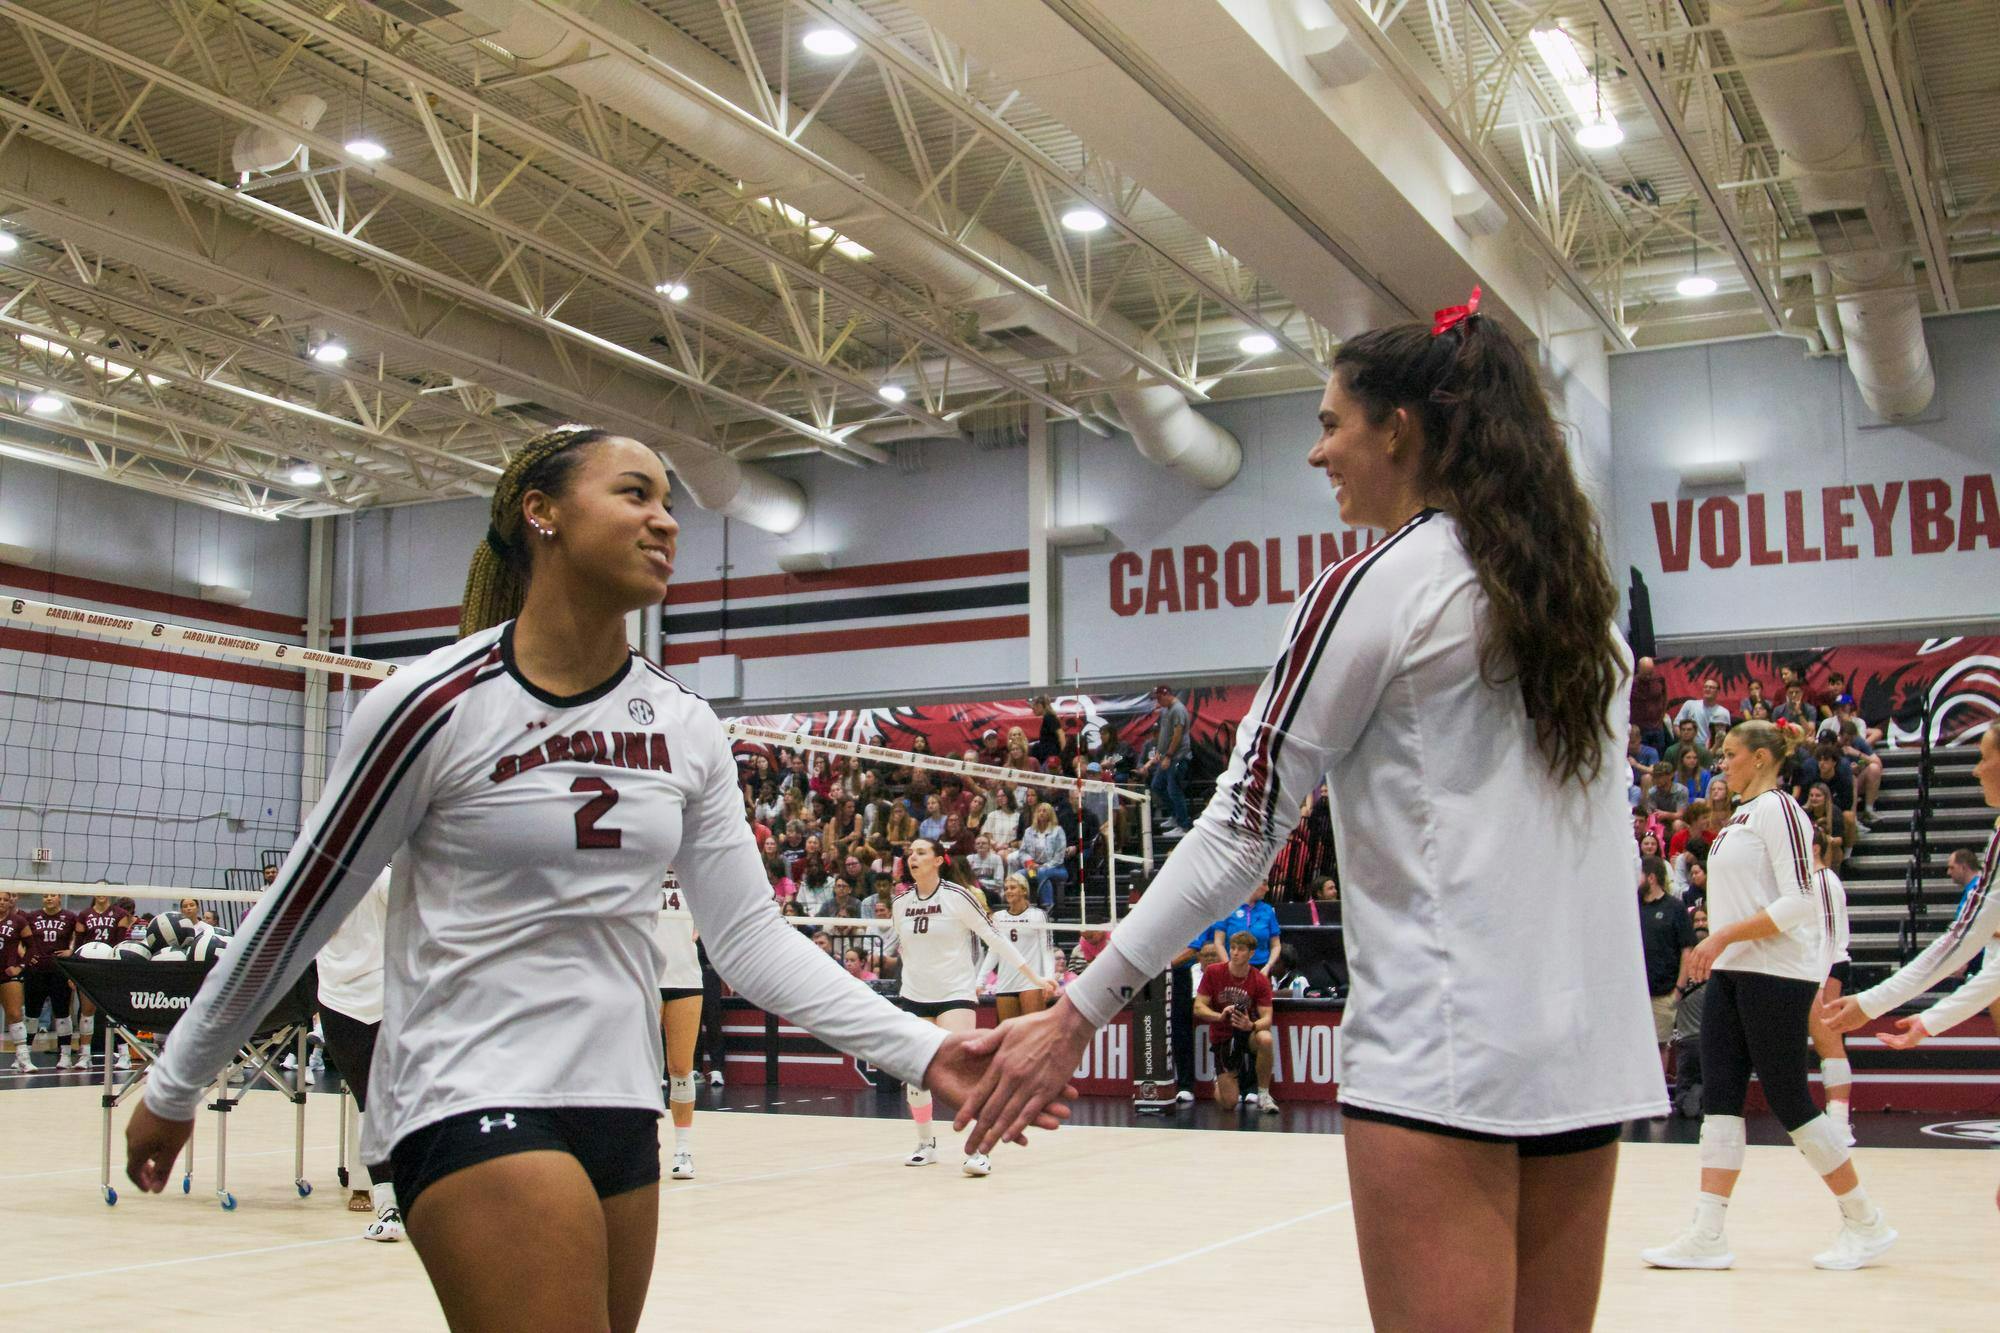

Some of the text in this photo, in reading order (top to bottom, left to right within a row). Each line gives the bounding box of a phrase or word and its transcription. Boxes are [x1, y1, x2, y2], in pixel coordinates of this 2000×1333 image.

[1651, 473, 2000, 573] VOLLEYBA
[1110, 528, 1374, 617] CAROLI
[46, 607, 85, 623] CAROLINA
[87, 614, 134, 630] GAMECOCKS
[182, 630, 217, 645] CAROLINA
[217, 637, 260, 651] GAMECOCKS
[303, 651, 335, 664] CAROLINA
[335, 657, 373, 671] GAMECOCKS
[570, 776, 622, 849] 2
[37, 849, 49, 861] EXIT
[34, 920, 66, 930] STATE
[87, 917, 116, 929] STATE
[913, 917, 929, 934] 10
[43, 930, 57, 942] 10
[95, 929, 109, 940] 24
[1010, 928, 1018, 942] 6
[129, 991, 191, 1009] Wilson
[1142, 1015, 1153, 1075] sports imports
